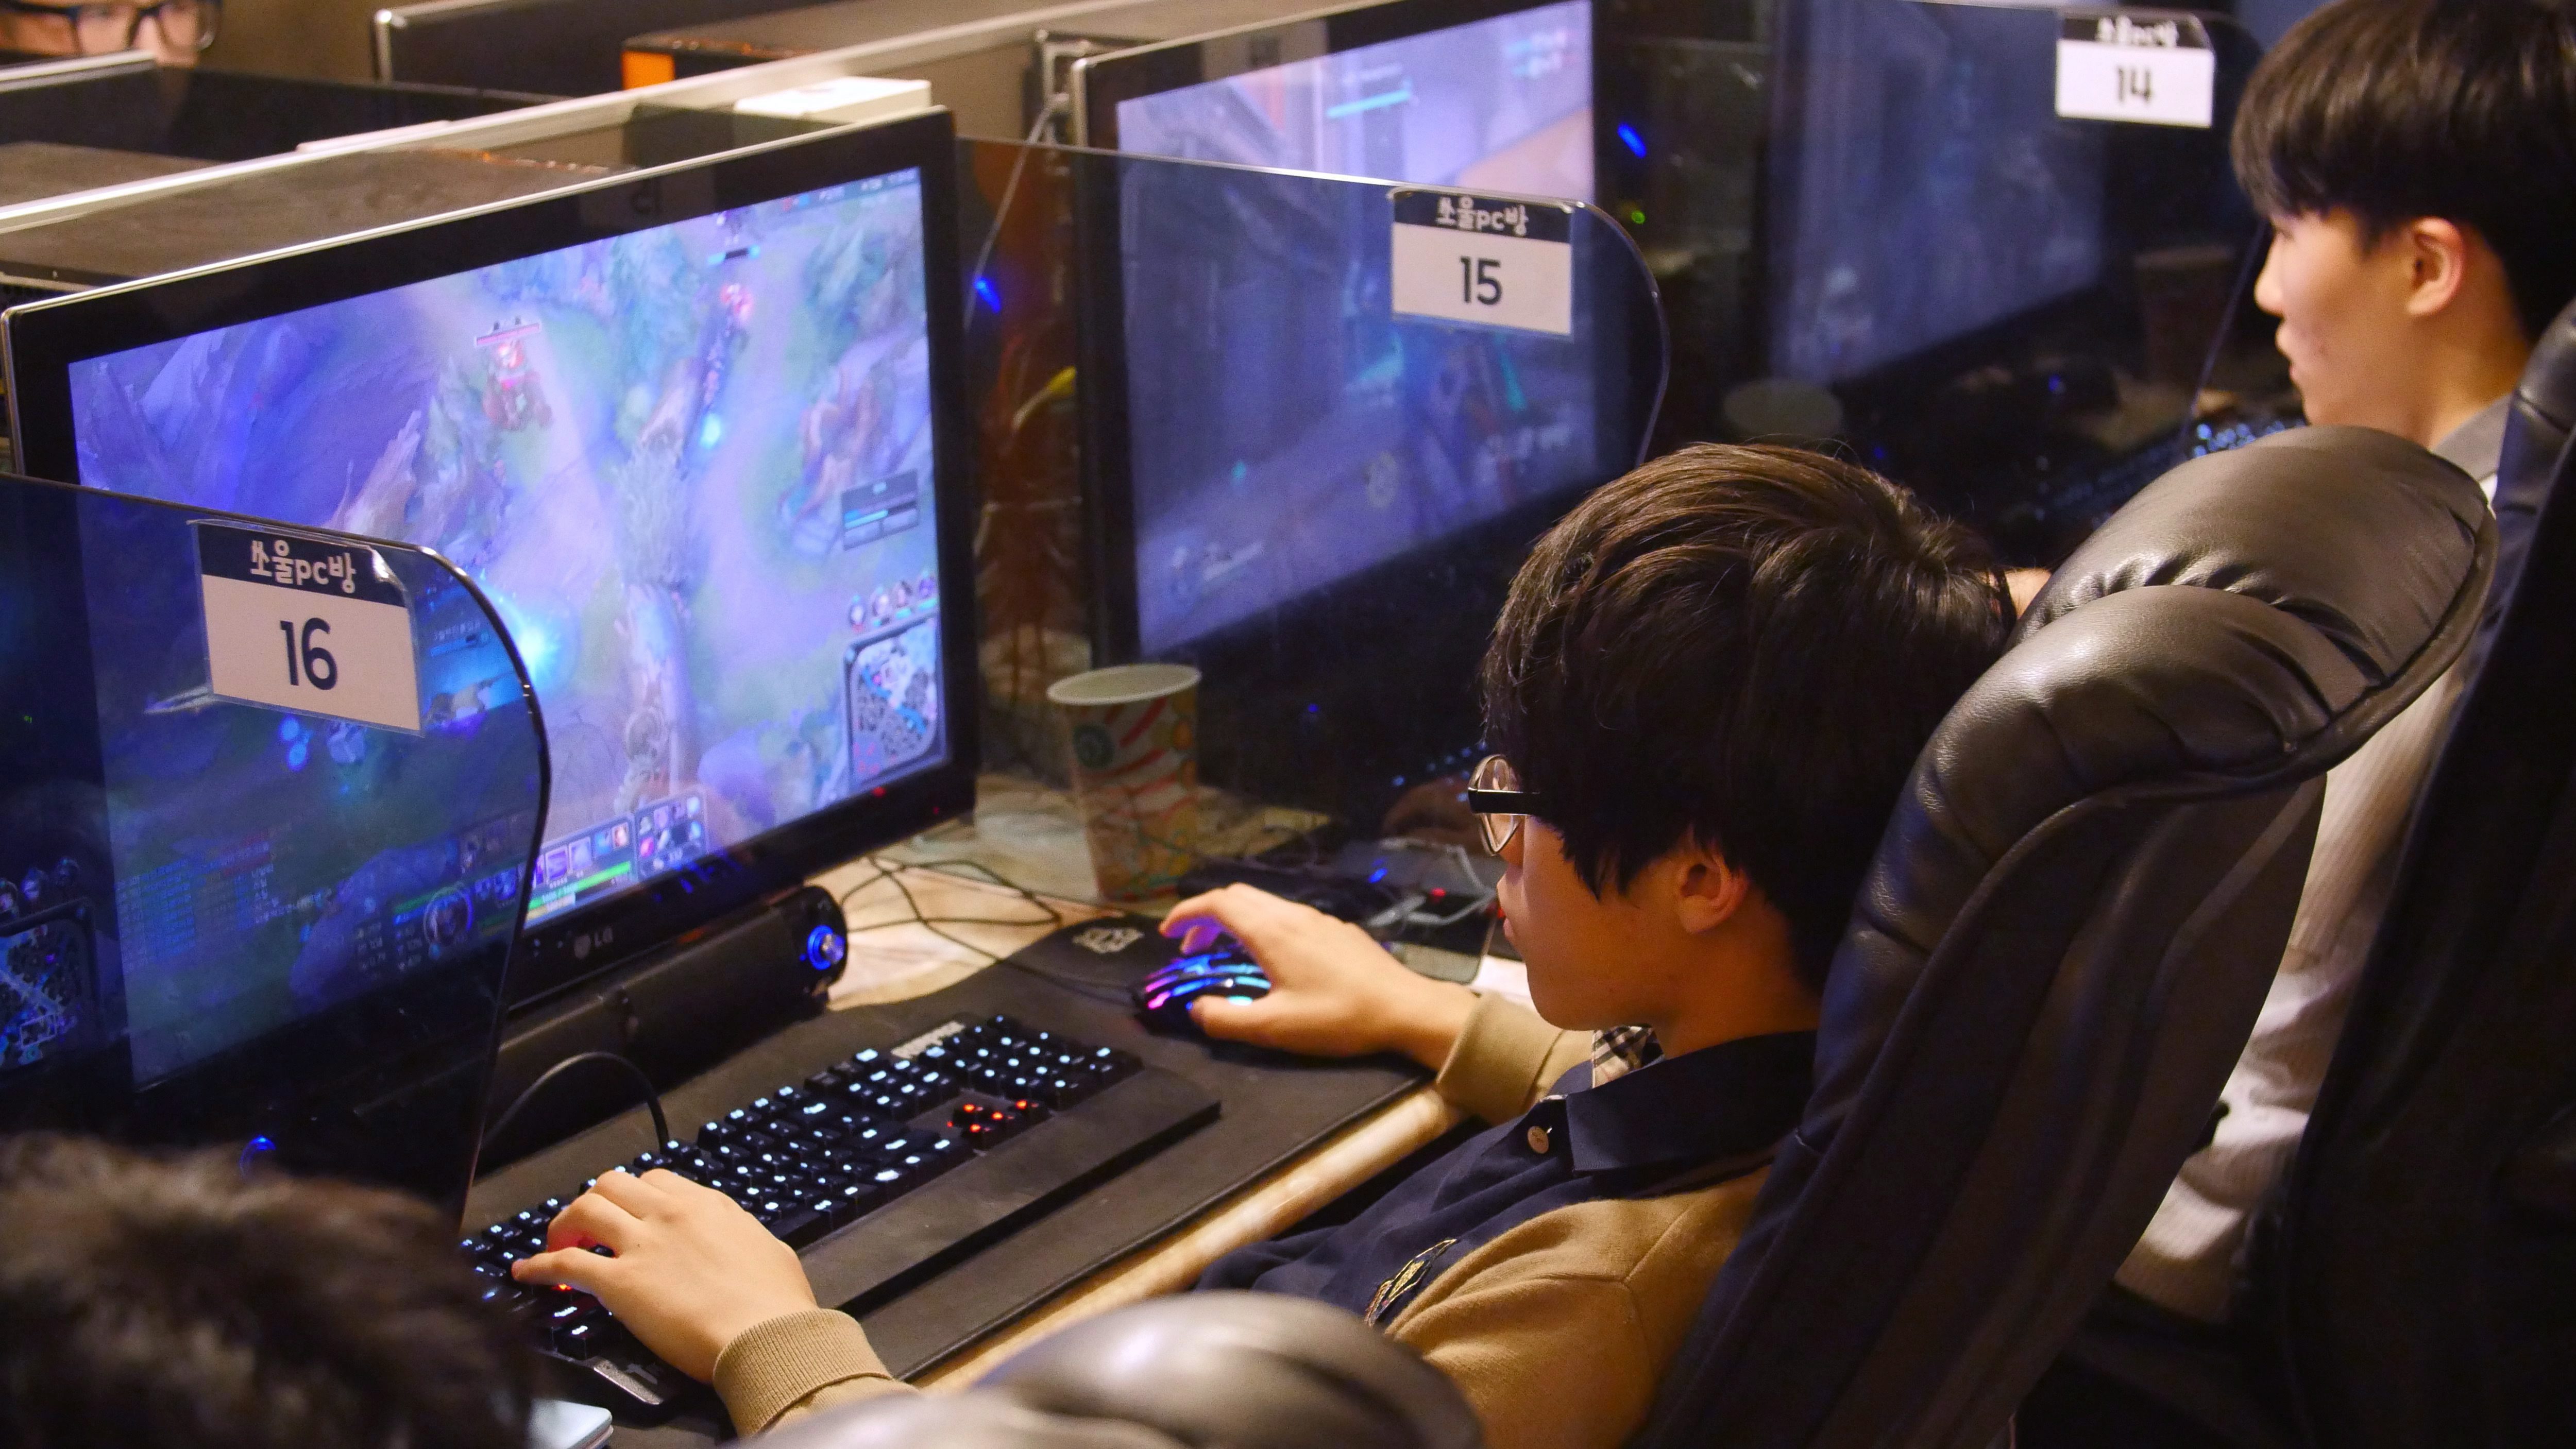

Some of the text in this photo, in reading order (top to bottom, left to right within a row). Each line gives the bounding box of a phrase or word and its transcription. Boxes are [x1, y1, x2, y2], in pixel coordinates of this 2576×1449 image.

[2117, 65, 2152, 104] 14
[1460, 255, 1502, 305] 15
[280, 617, 338, 690] 16
